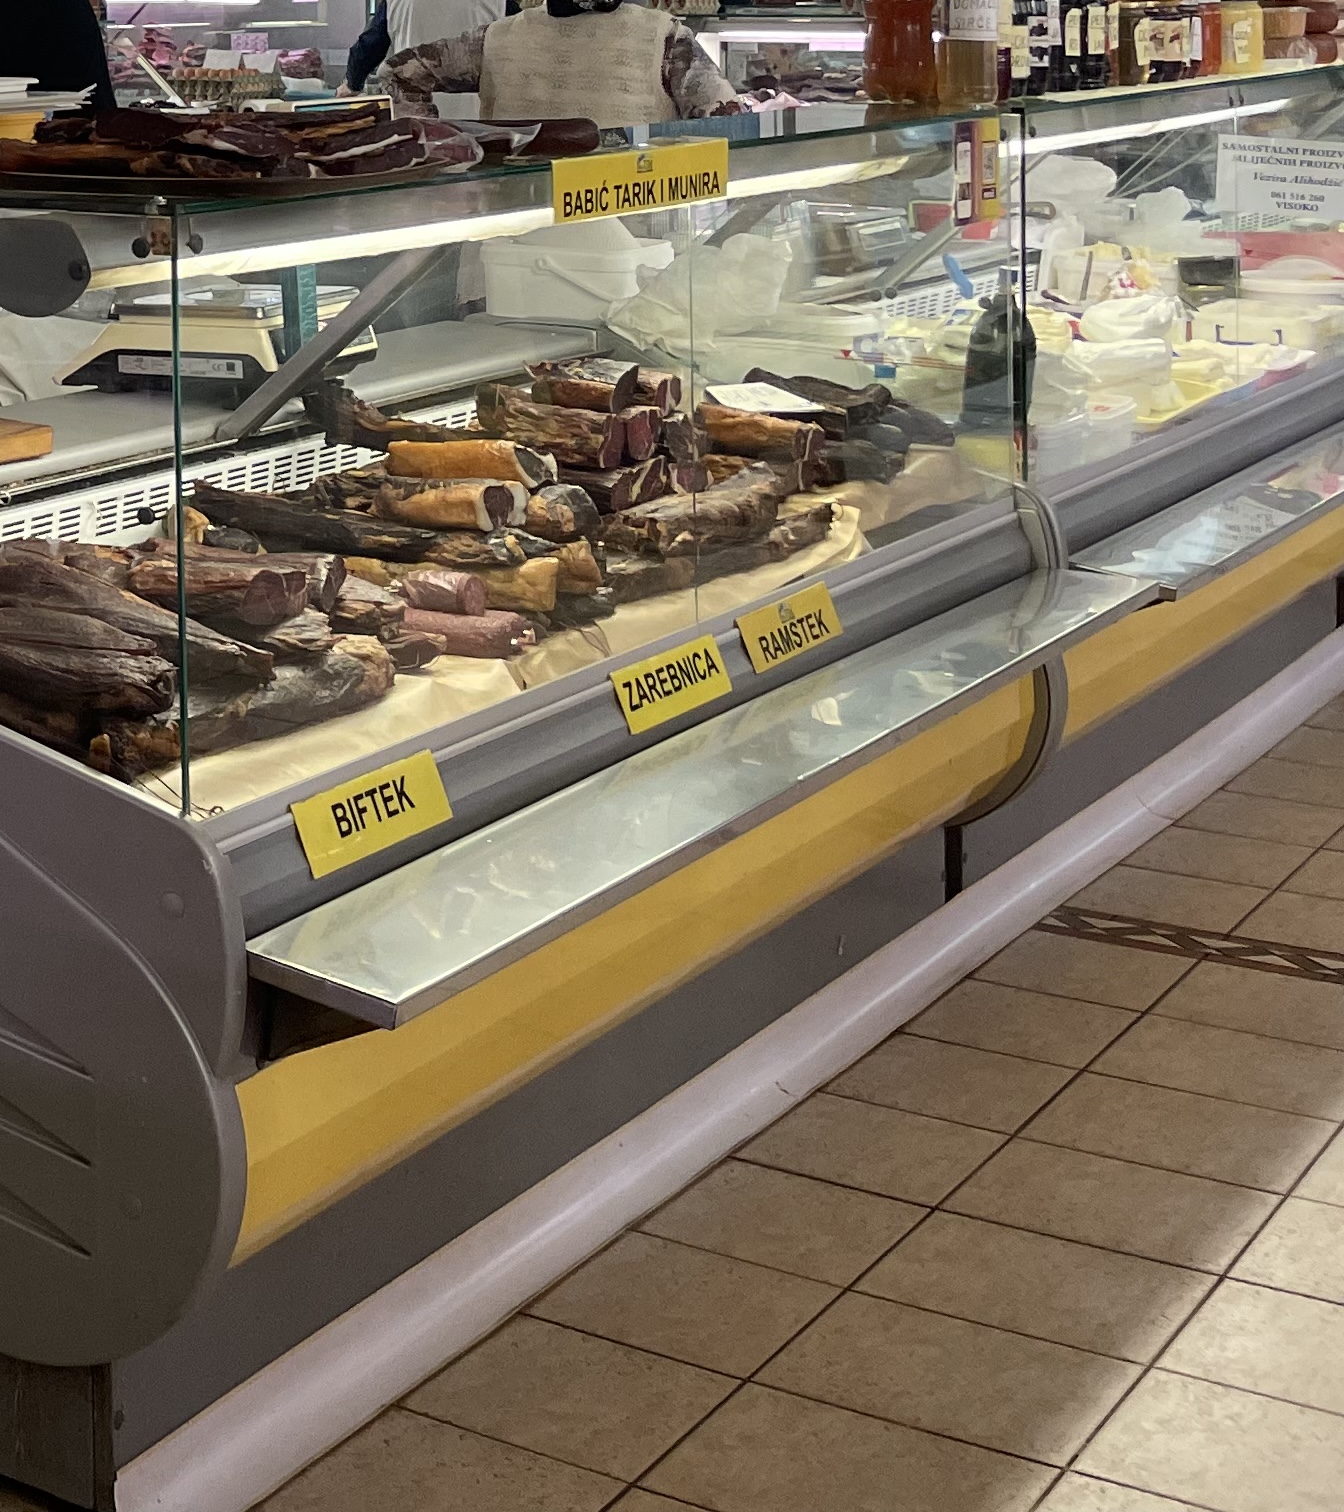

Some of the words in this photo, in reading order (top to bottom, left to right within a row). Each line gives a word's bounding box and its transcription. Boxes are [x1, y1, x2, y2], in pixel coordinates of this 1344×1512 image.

[1222, 142, 1299, 156] SAMOSTALNI
[563, 179, 610, 218] BABIĆ
[614, 179, 657, 210] TARIK
[660, 178, 664, 203] I
[667, 170, 721, 202] MUNIRA
[1275, 200, 1319, 212] VISOKO
[757, 608, 831, 664] RAMSTEK
[621, 648, 720, 712] ZAREBNICA
[330, 774, 416, 839] BIFTEK
